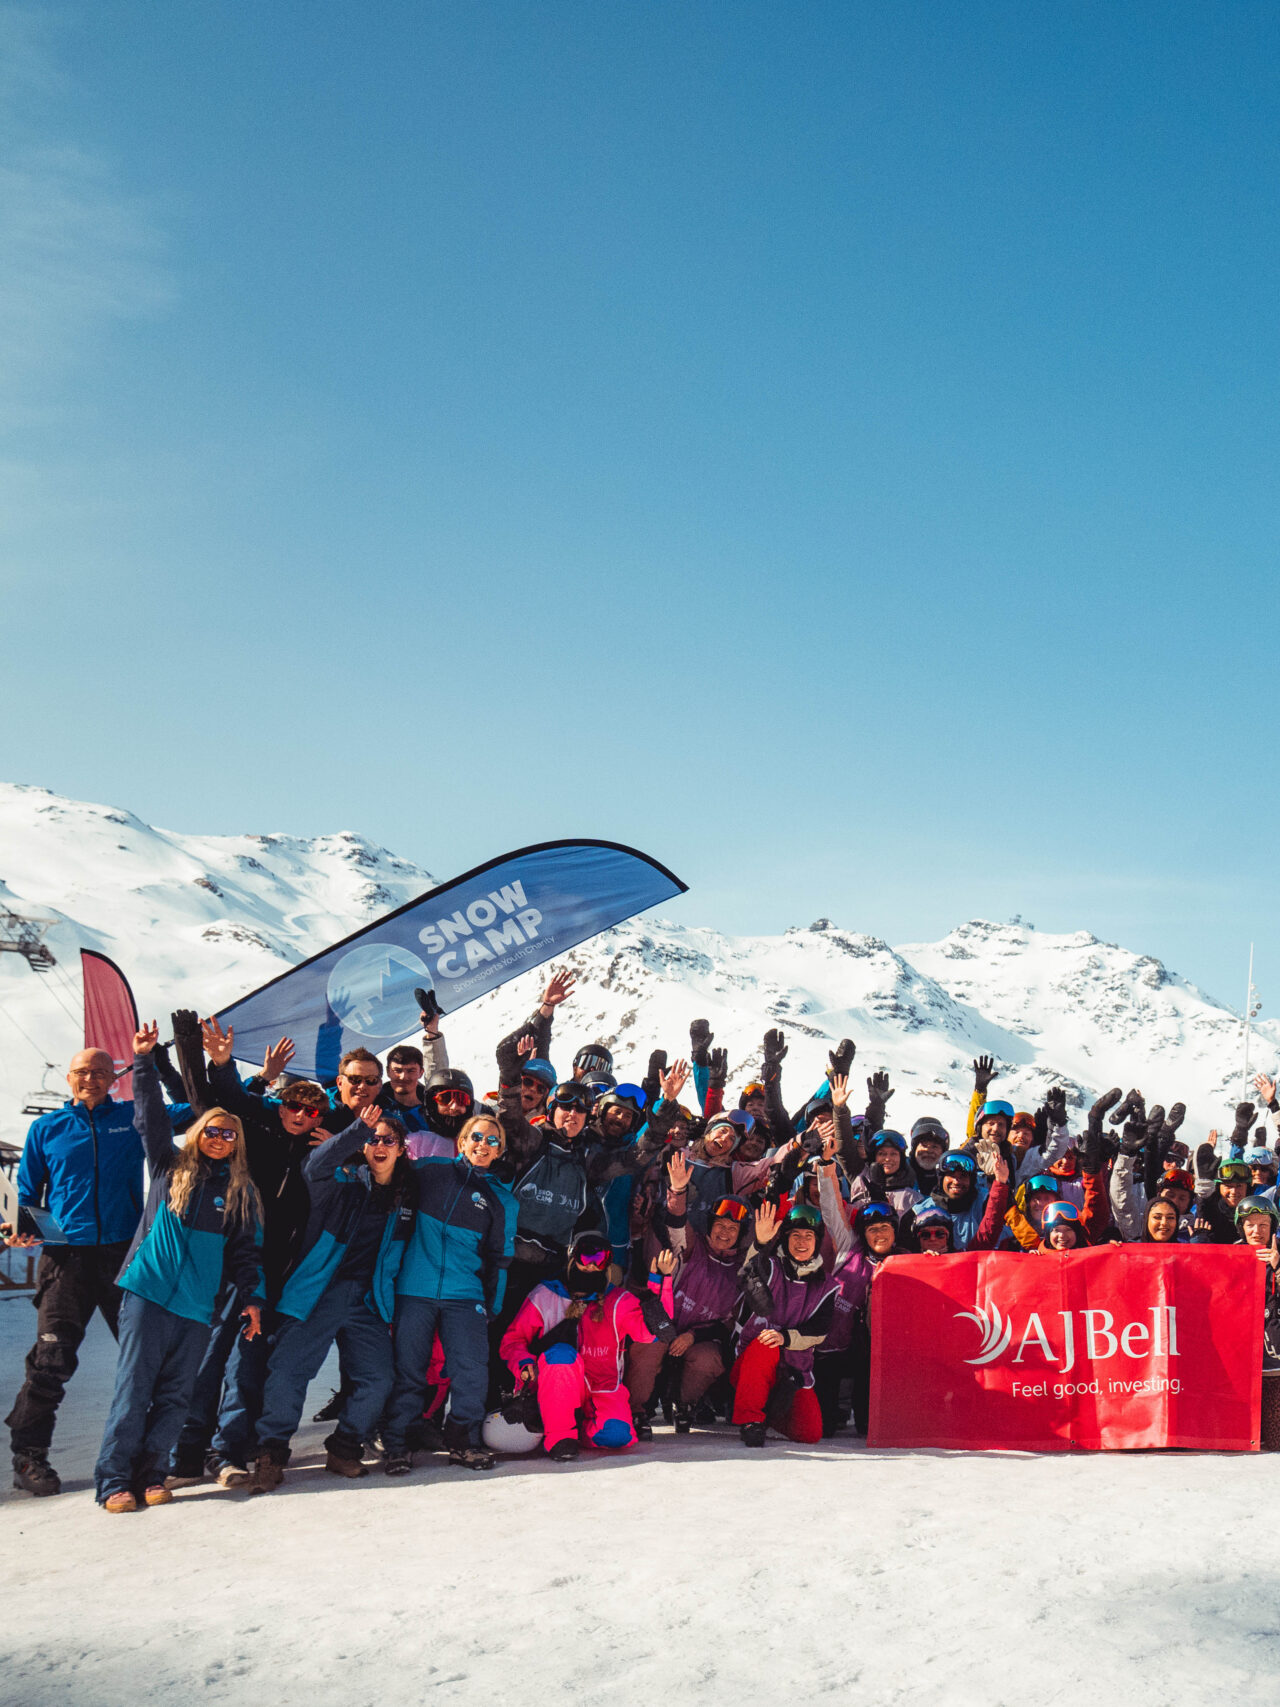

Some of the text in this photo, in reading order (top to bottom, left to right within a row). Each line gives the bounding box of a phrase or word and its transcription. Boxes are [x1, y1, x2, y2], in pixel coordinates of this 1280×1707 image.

[418, 879, 528, 954] SNOW
[436, 908, 543, 979] CAMP
[453, 935, 555, 993] Snowsports Youth Charity
[1012, 1376, 1184, 1400] Feel good, investing.
